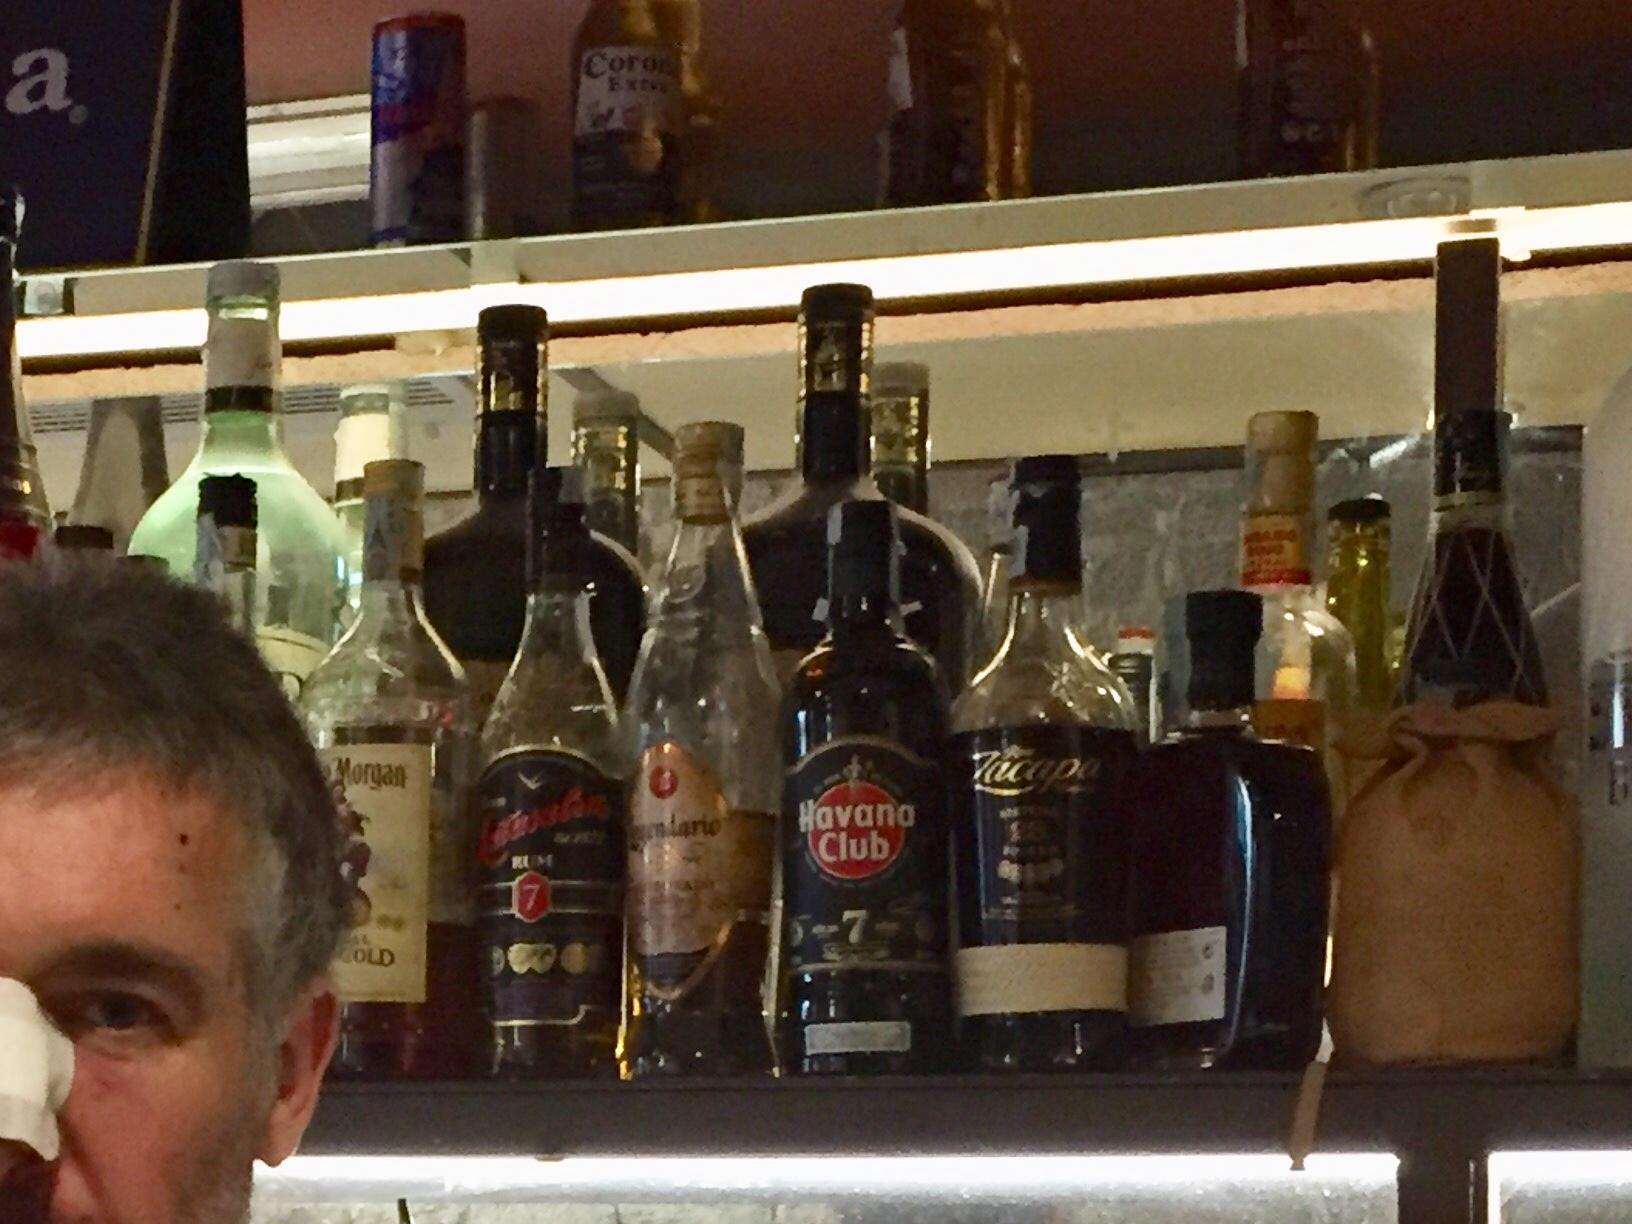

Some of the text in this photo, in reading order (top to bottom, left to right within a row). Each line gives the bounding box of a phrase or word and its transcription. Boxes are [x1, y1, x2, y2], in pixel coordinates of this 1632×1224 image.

[336, 757, 407, 791] Morgan
[799, 799, 916, 833] Havana
[511, 854, 554, 869] RUM
[818, 831, 891, 863] Club
[522, 883, 541, 911] 7
[841, 909, 868, 945] 7
